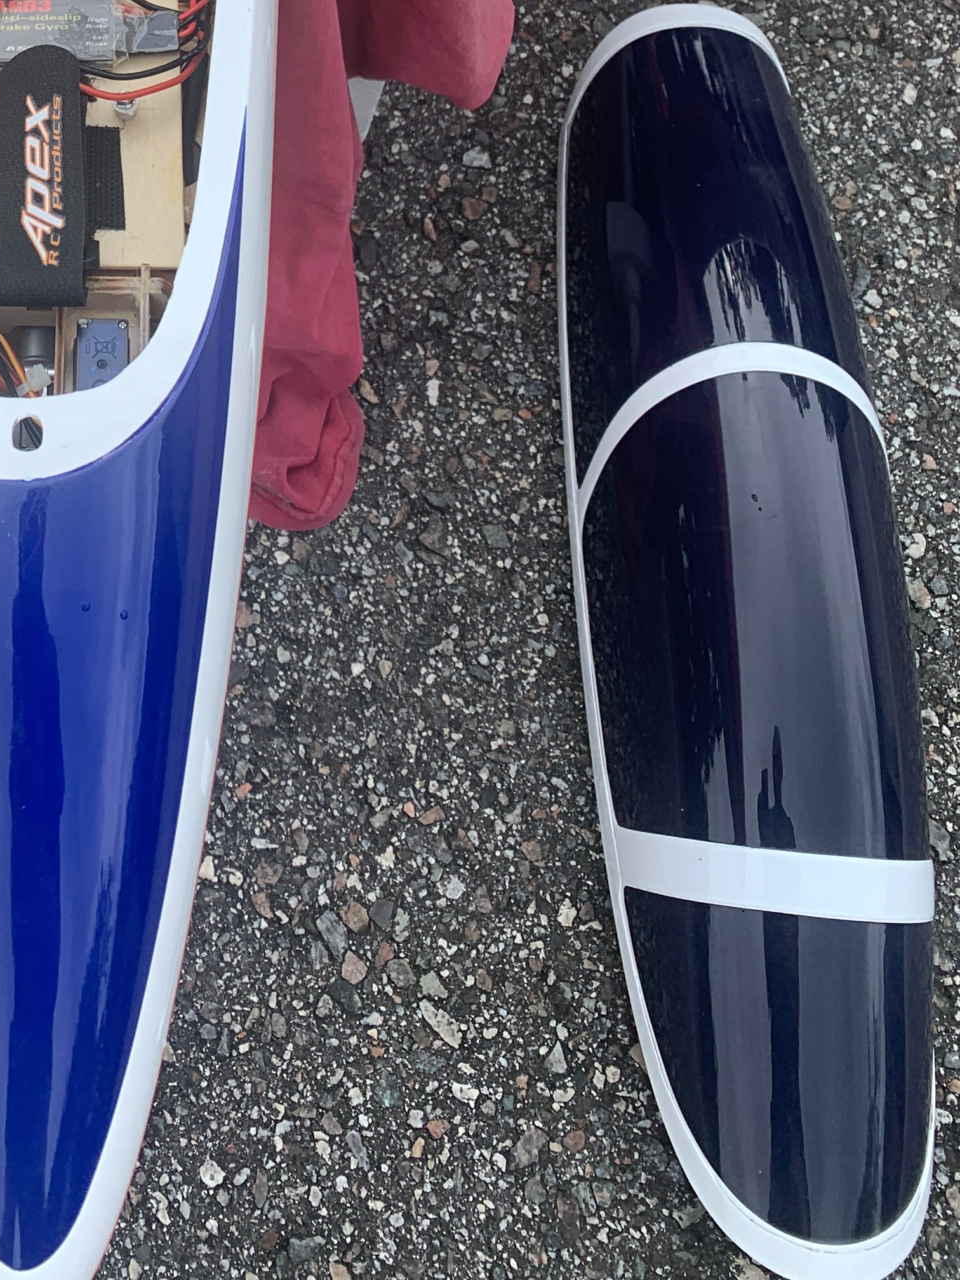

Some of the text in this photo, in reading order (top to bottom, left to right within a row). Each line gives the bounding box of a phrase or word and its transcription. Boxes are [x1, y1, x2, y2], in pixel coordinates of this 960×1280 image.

[35, 23, 69, 32] Gyro
[87, 16, 109, 24] Right
[21, 93, 65, 266] Apex
[52, 93, 63, 210] Products
